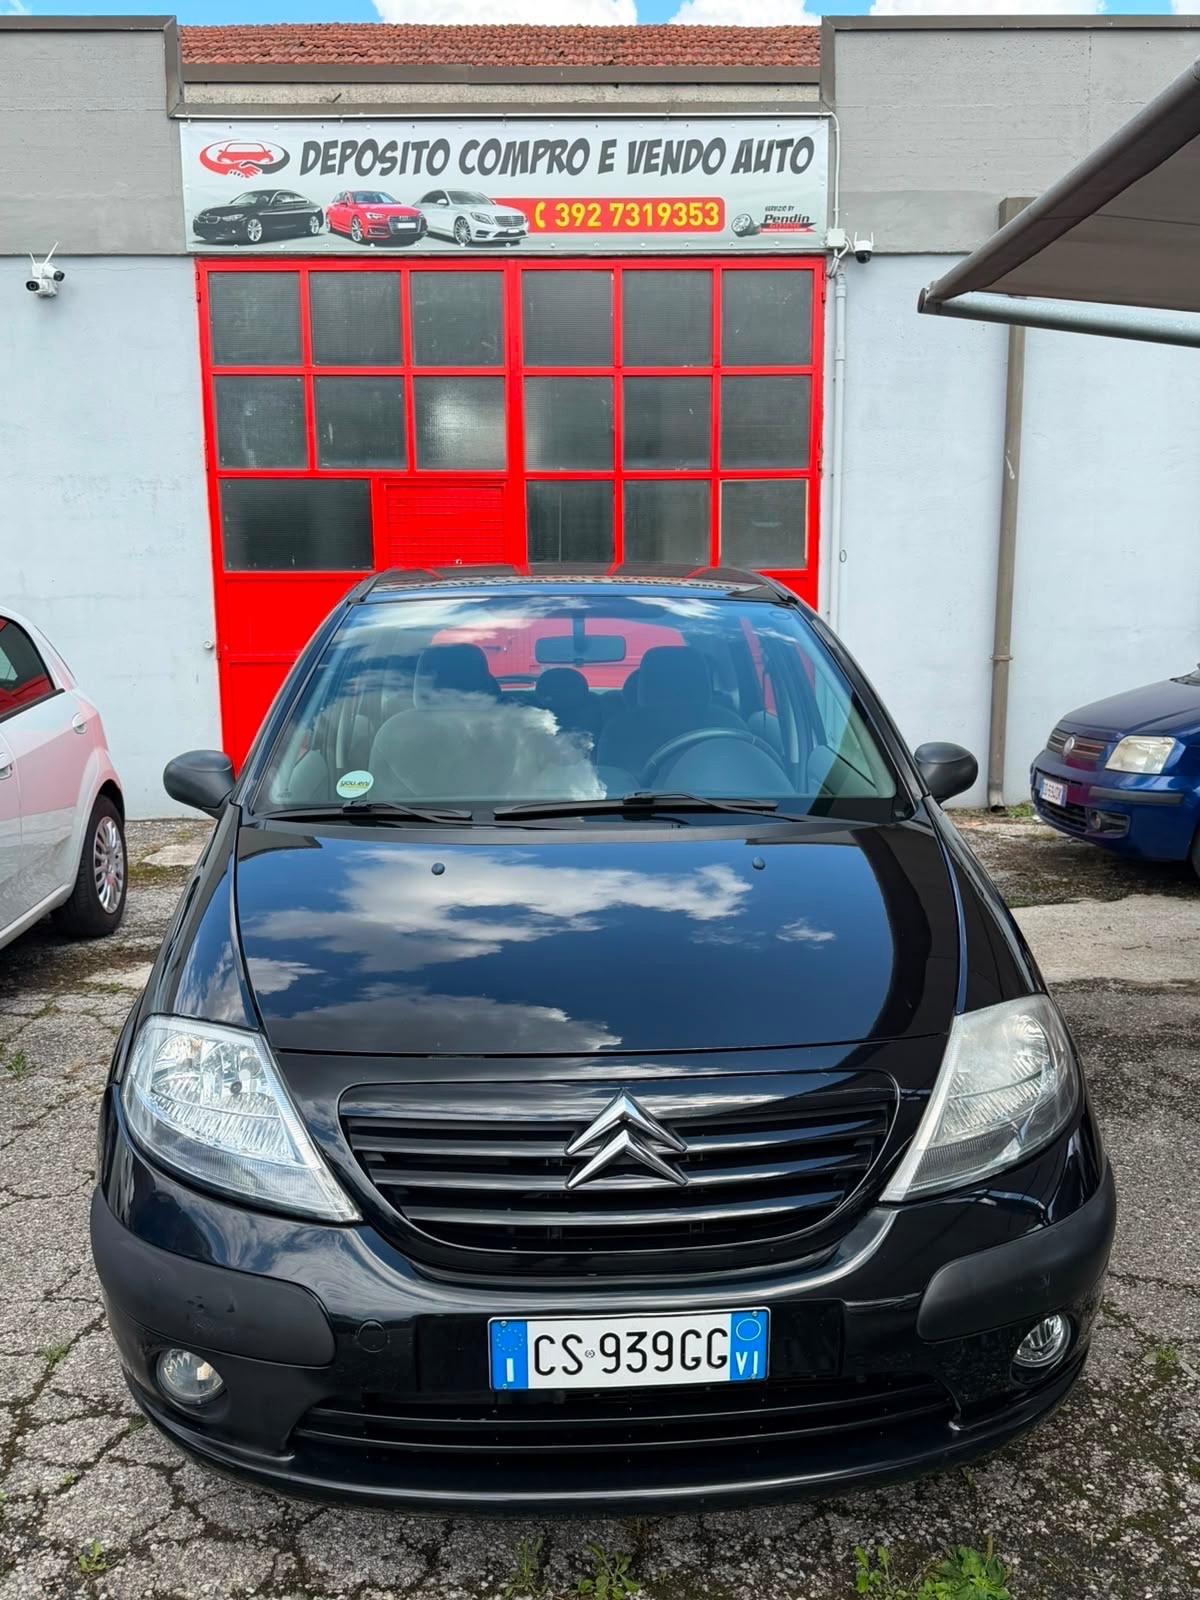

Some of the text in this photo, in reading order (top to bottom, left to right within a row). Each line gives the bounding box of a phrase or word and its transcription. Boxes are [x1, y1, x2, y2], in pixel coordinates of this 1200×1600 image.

[300, 136, 815, 177] DEPOSITO COMPRO E VENDO AUTO
[555, 201, 720, 228] 392 7319353
[764, 214, 810, 224] Pendin
[735, 1350, 758, 1375] VI
